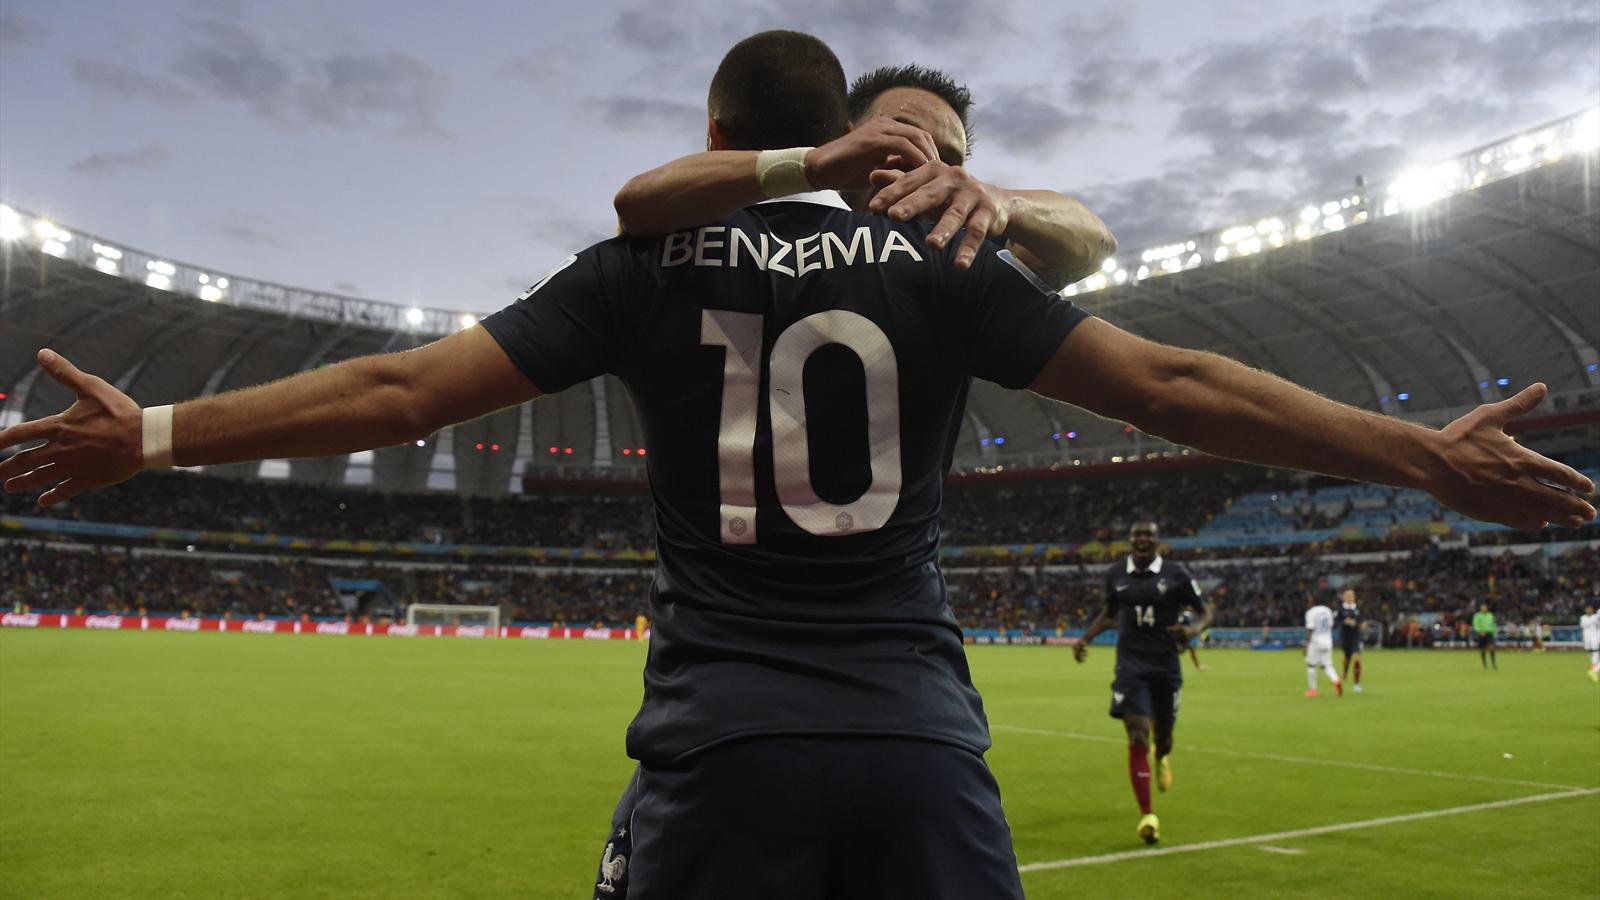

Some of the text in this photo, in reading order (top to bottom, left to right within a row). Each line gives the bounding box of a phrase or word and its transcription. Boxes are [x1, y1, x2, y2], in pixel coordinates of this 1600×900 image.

[661, 226, 923, 277] BENZEMA
[700, 309, 902, 544] 10
[1134, 605, 1155, 627] 14
